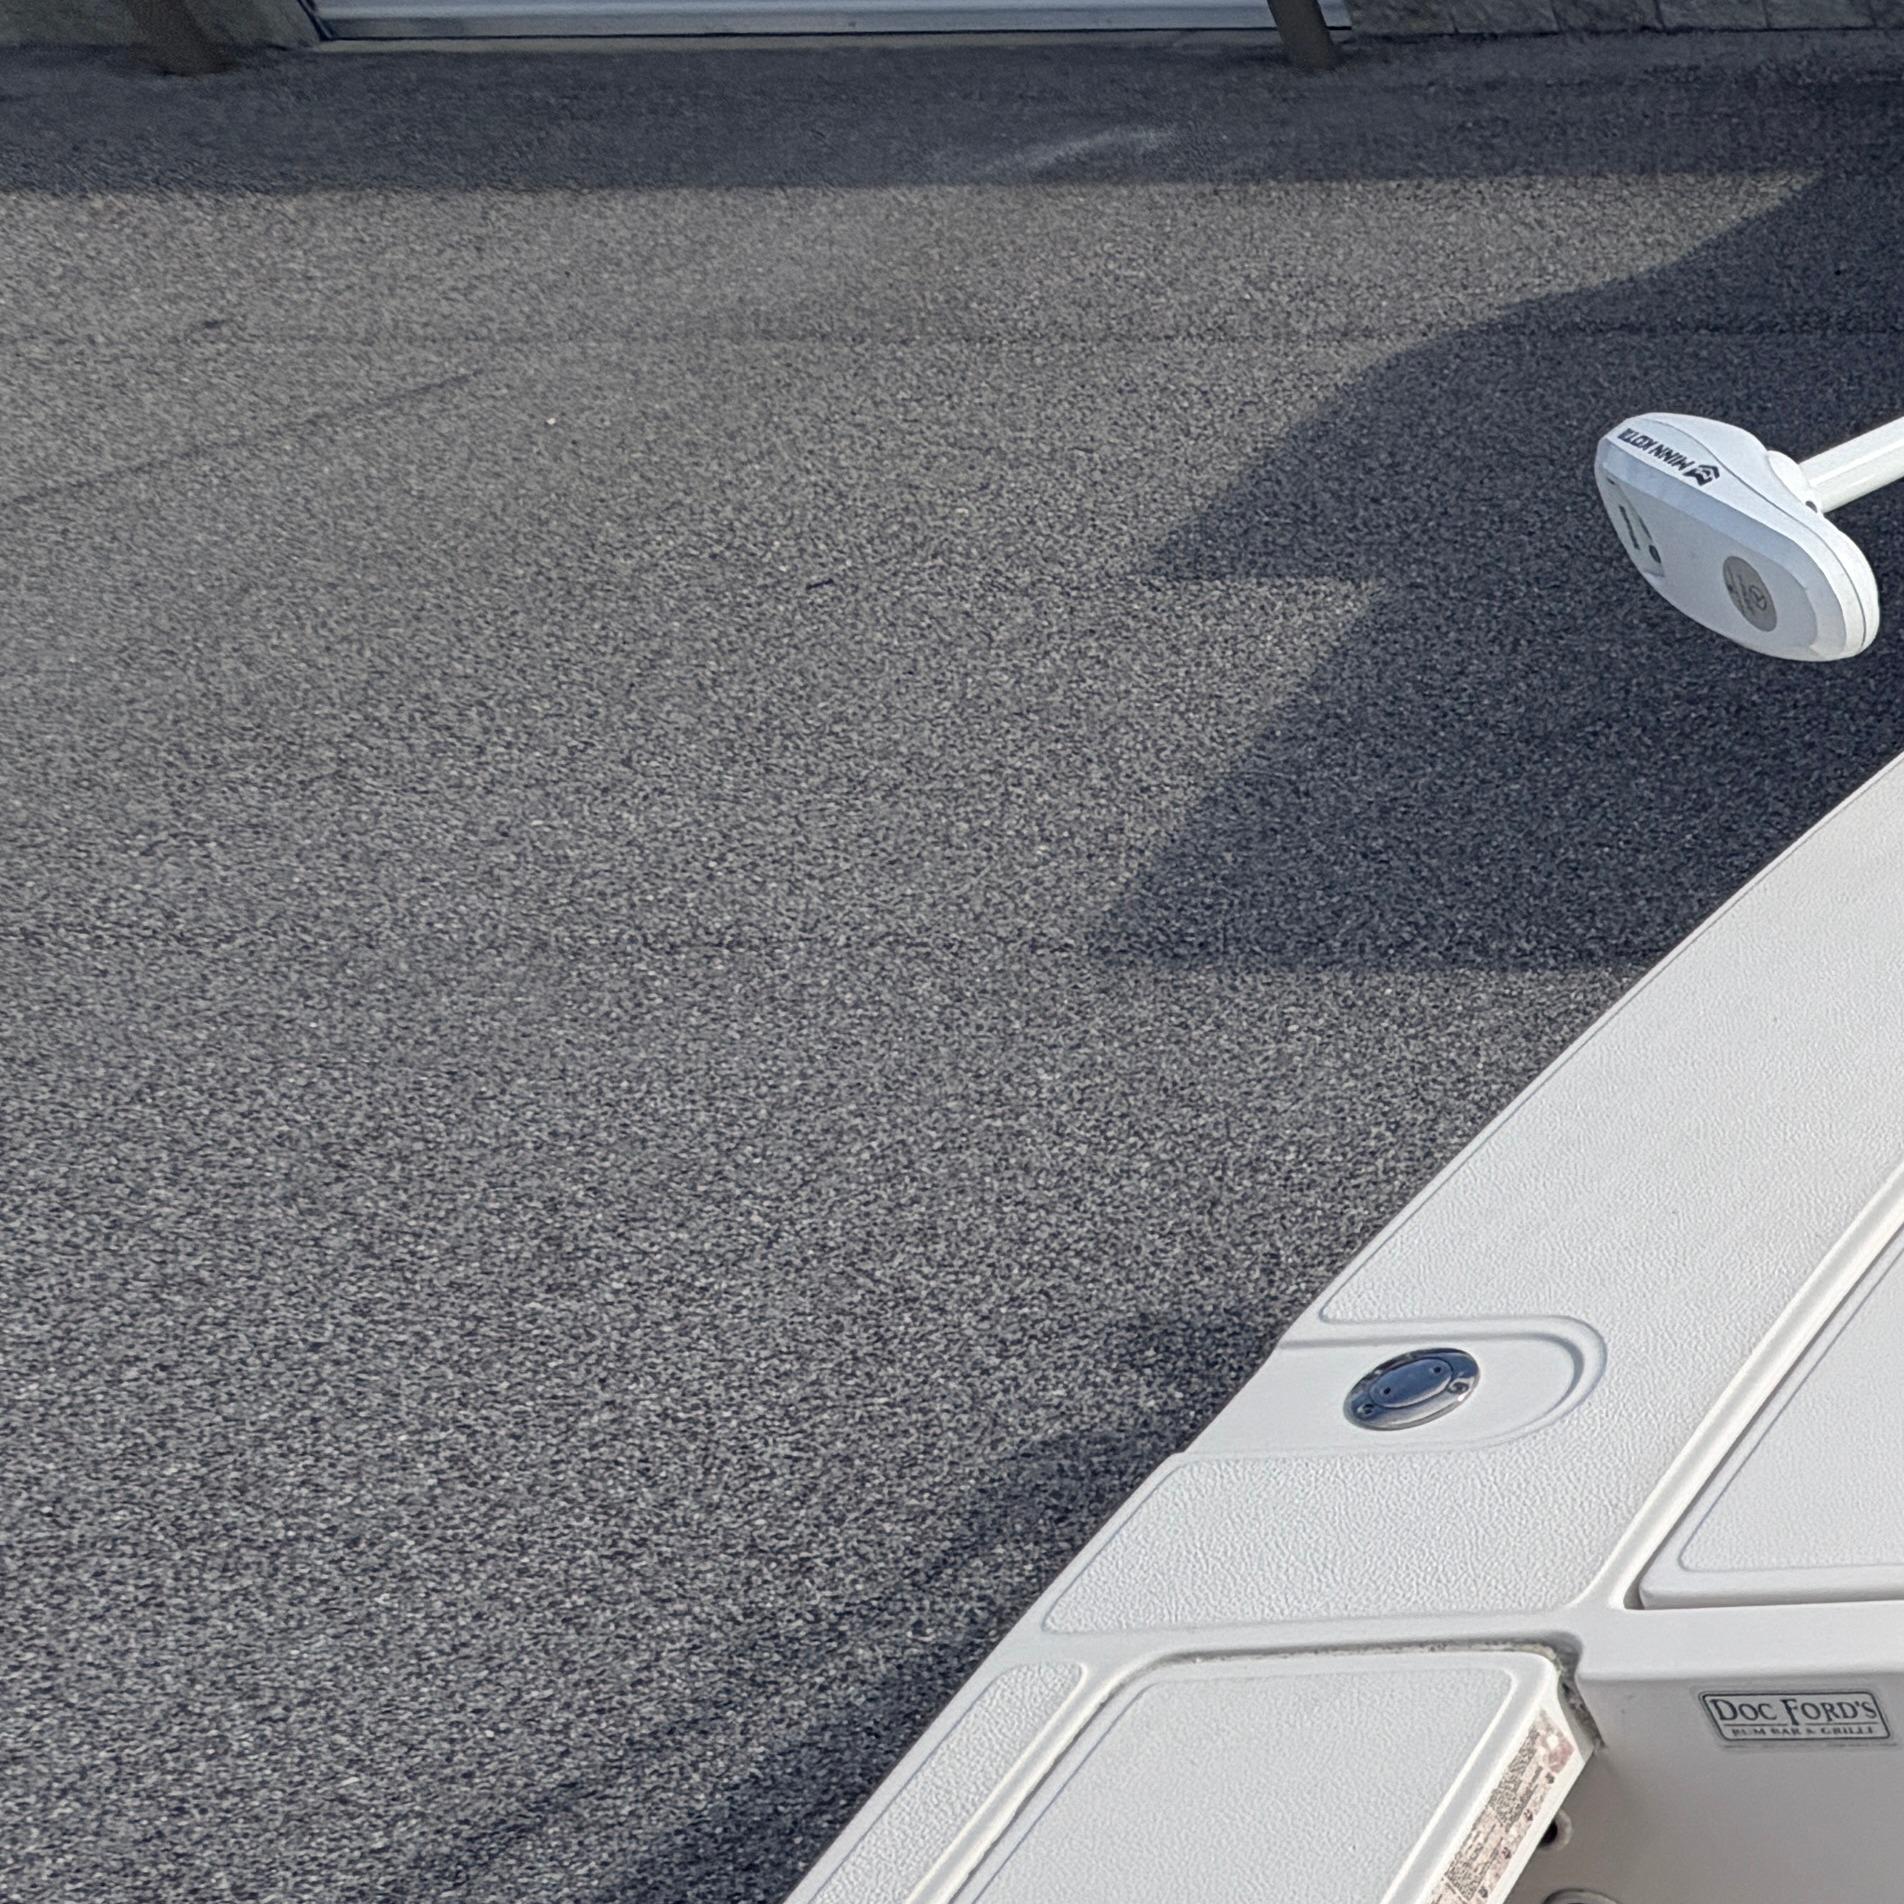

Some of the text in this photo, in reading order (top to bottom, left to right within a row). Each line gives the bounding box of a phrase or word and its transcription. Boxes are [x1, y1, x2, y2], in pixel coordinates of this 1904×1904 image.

[1617, 427, 1696, 472] MINN KOTA
[1708, 1697, 1878, 1726] DOC FORD'S
